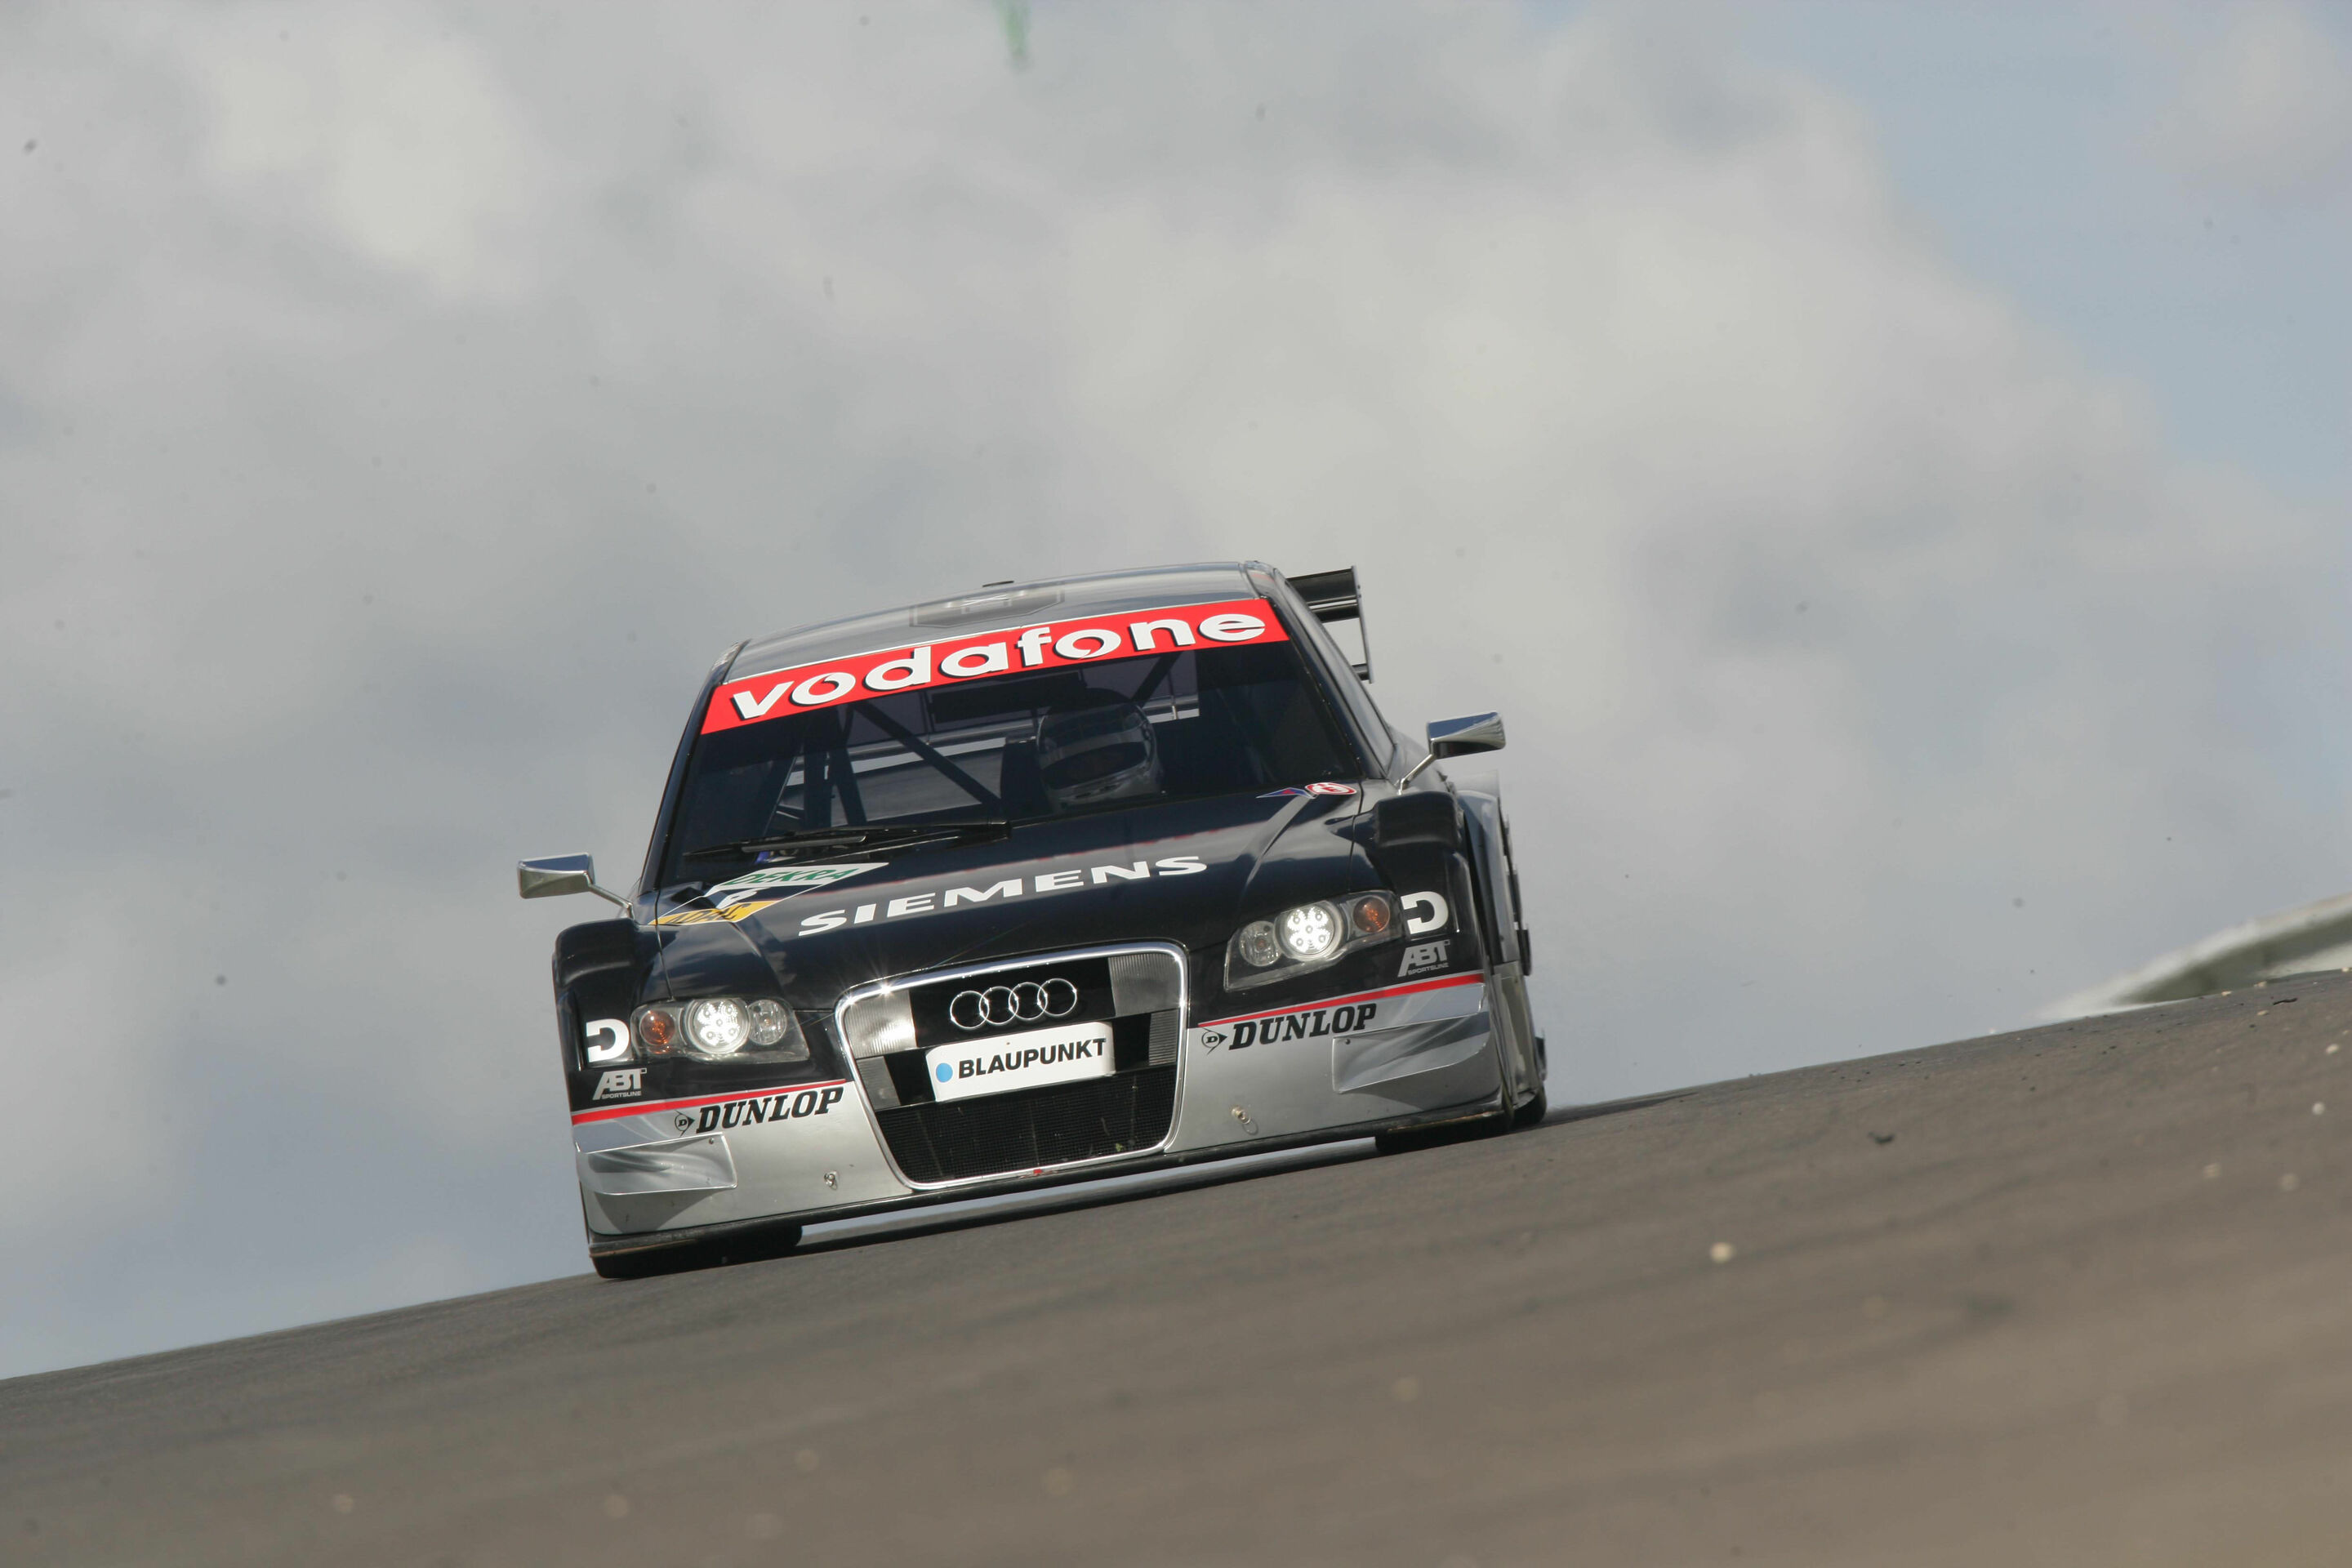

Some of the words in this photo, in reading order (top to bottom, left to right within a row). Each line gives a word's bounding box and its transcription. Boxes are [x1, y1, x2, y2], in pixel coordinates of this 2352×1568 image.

[731, 613, 1266, 721] vodafone
[721, 867, 859, 886] DEKRA
[798, 855, 1207, 936] SIEMENS
[1397, 939, 1450, 978] ABT
[1228, 1002, 1378, 1051] DUNLOP
[958, 1037, 1107, 1080] BLAUPUNKT
[592, 1067, 644, 1101] ABT
[601, 1090, 642, 1100] SPORTSLINE
[696, 1086, 844, 1134] DUNLOP
